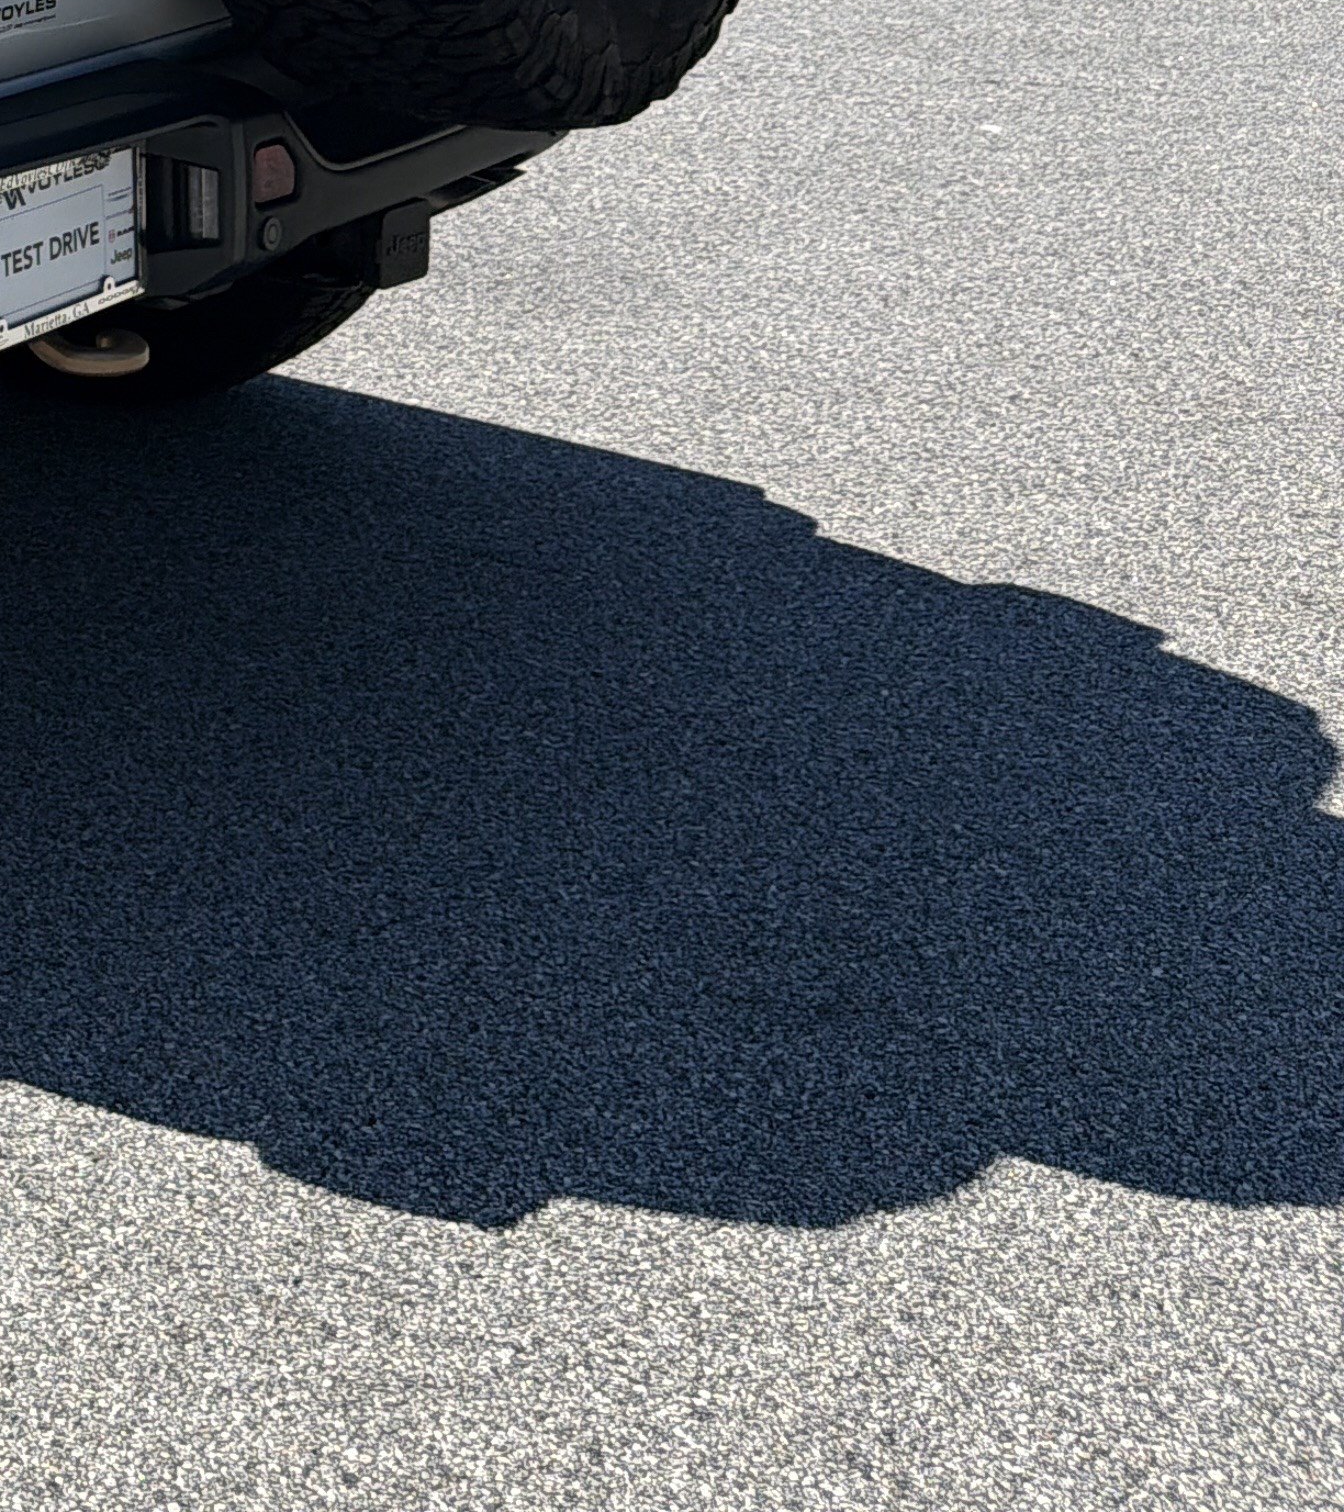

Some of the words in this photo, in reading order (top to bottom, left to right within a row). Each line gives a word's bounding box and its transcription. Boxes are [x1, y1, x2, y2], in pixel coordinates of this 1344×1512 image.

[1, 241, 43, 277] TEST
[49, 221, 100, 260] DRIVE
[110, 248, 132, 265] Jeep
